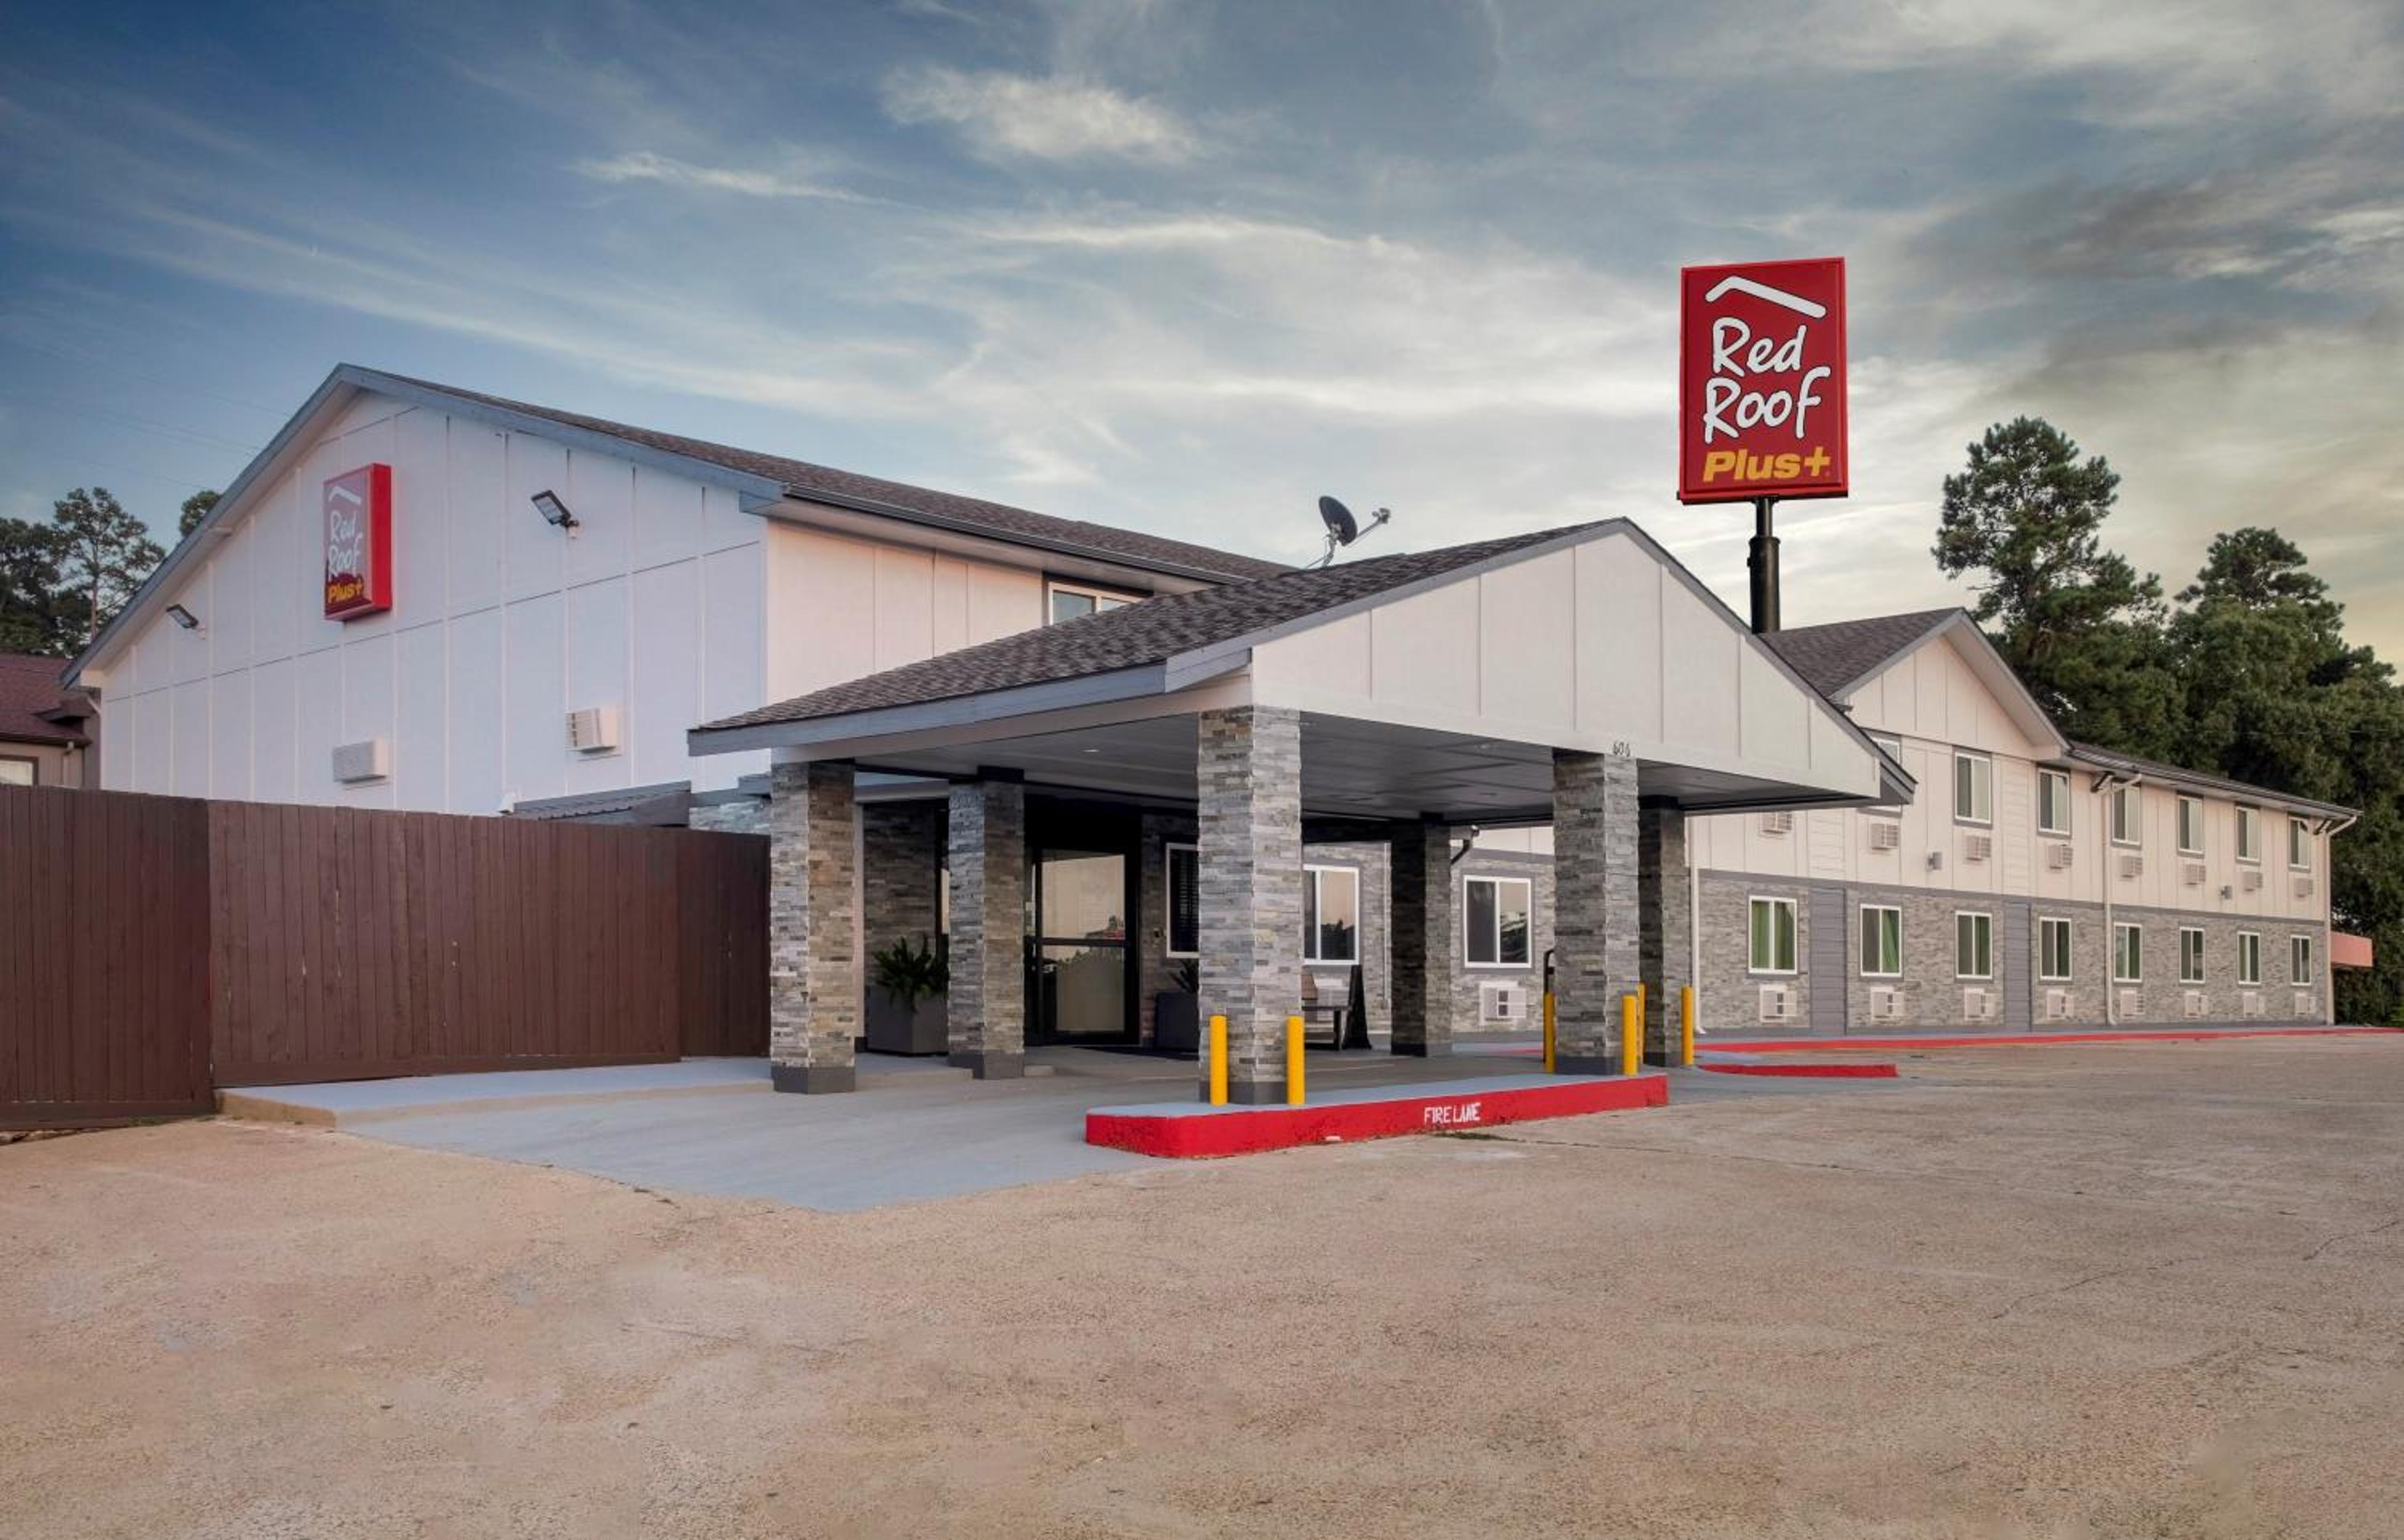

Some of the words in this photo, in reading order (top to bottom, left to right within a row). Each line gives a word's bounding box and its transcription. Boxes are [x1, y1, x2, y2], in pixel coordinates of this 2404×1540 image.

[1712, 317, 1806, 377] Red
[1703, 366, 1831, 444] Roof
[1703, 446, 1830, 482] Plus+
[330, 510, 357, 542] Red
[329, 532, 363, 583] Roof
[1424, 1106, 1452, 1123] FIRE
[1453, 1103, 1481, 1122] LANE
